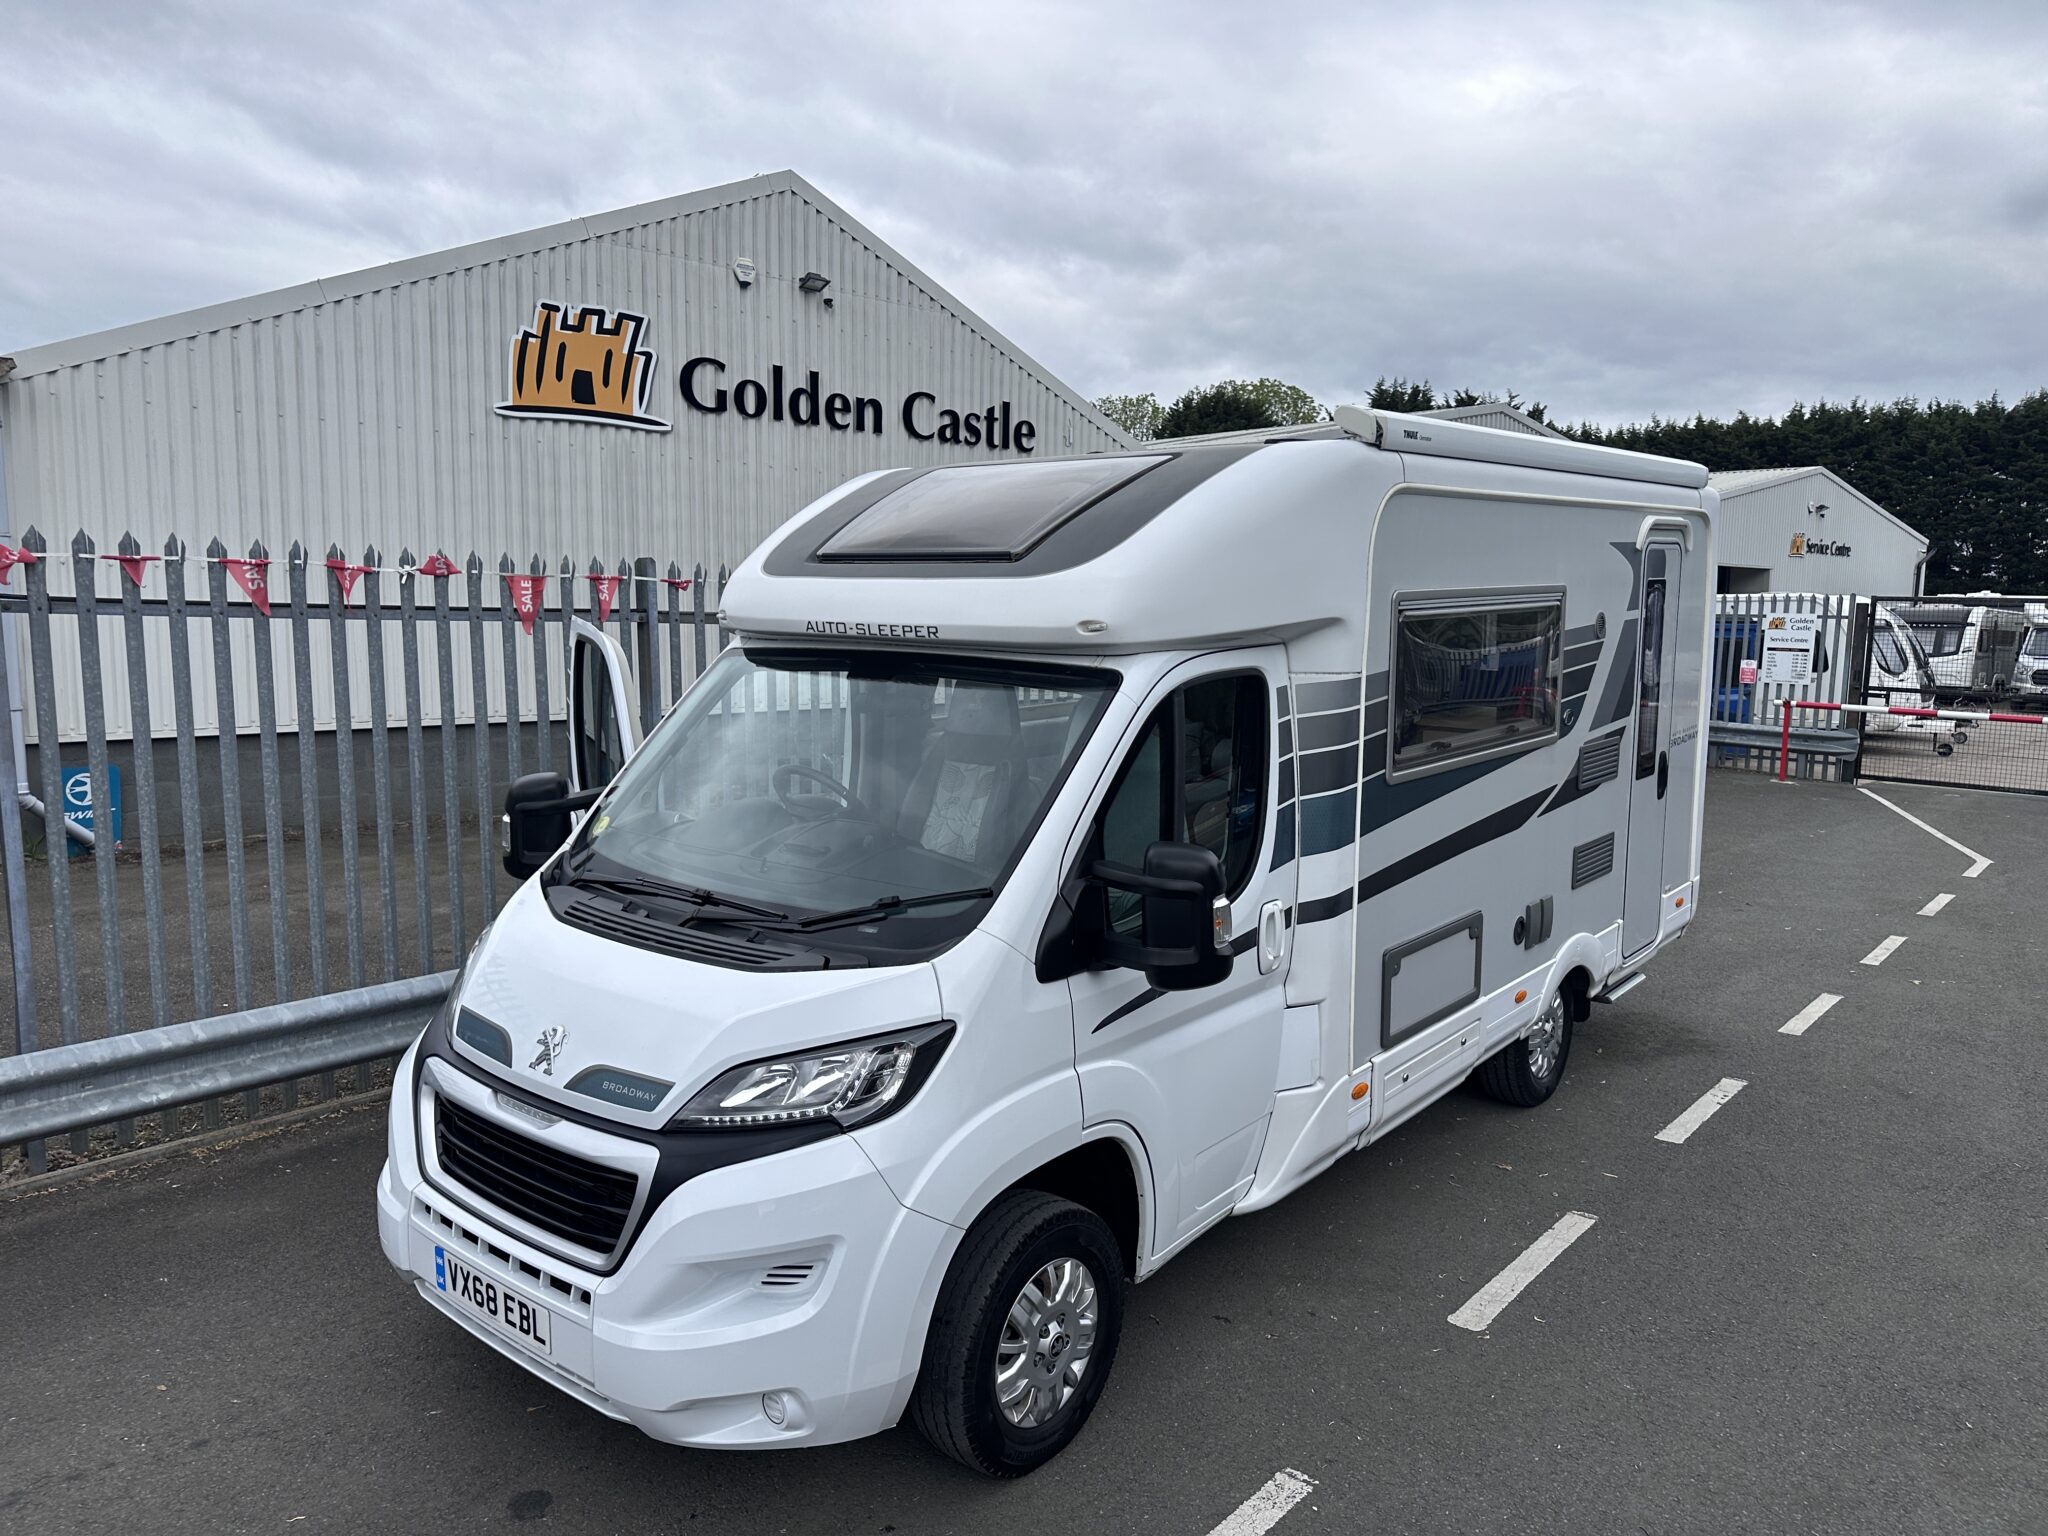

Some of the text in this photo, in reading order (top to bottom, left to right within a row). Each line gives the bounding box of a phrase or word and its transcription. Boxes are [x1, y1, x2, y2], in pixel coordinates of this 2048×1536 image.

[679, 356, 1036, 453] Golden Castle
[1806, 537, 1851, 557] Service Centre
[521, 580, 533, 613] SALE
[806, 620, 940, 638] AUTO-SLEEPER
[602, 1080, 657, 1101] BROADWAY
[447, 1258, 546, 1346] VX68 EBL
